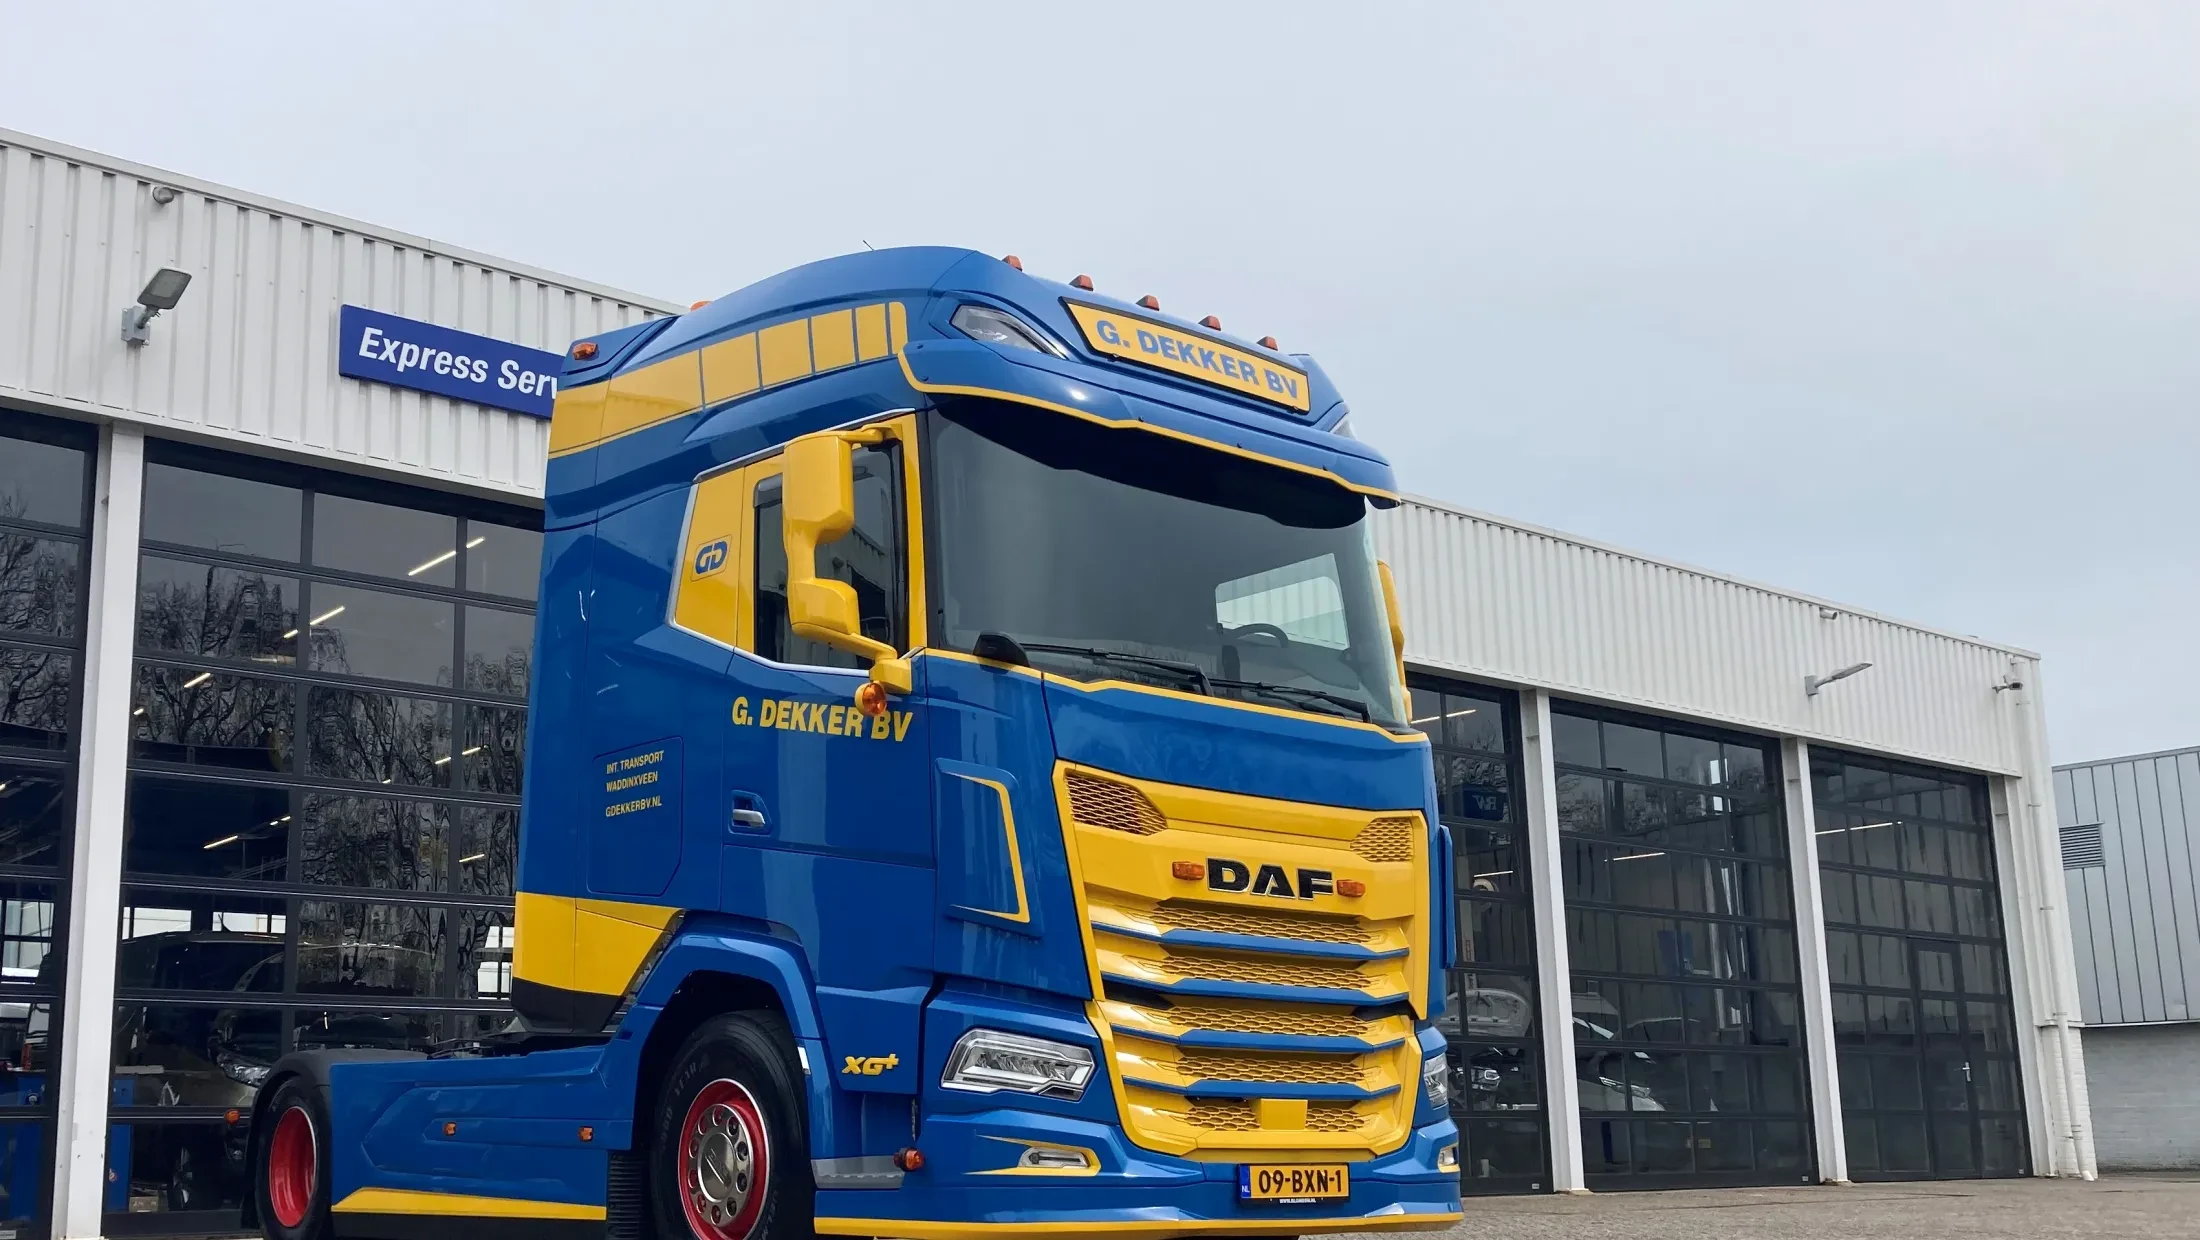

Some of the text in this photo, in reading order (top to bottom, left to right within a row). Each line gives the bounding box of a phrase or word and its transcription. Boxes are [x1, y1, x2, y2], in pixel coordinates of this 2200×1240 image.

[359, 326, 489, 383] Express
[1096, 320, 1298, 399] G. DEKKER BV
[732, 696, 913, 742] G. DEKKER BV
[620, 750, 665, 771] TRANSPORT
[606, 770, 659, 793] WADDINXVEEN
[605, 795, 663, 817] GDEKKERBV.NL
[1205, 857, 1334, 901] DAF
[1241, 1185, 1250, 1193] NL
[1258, 1169, 1342, 1194] 09-BXN-1
